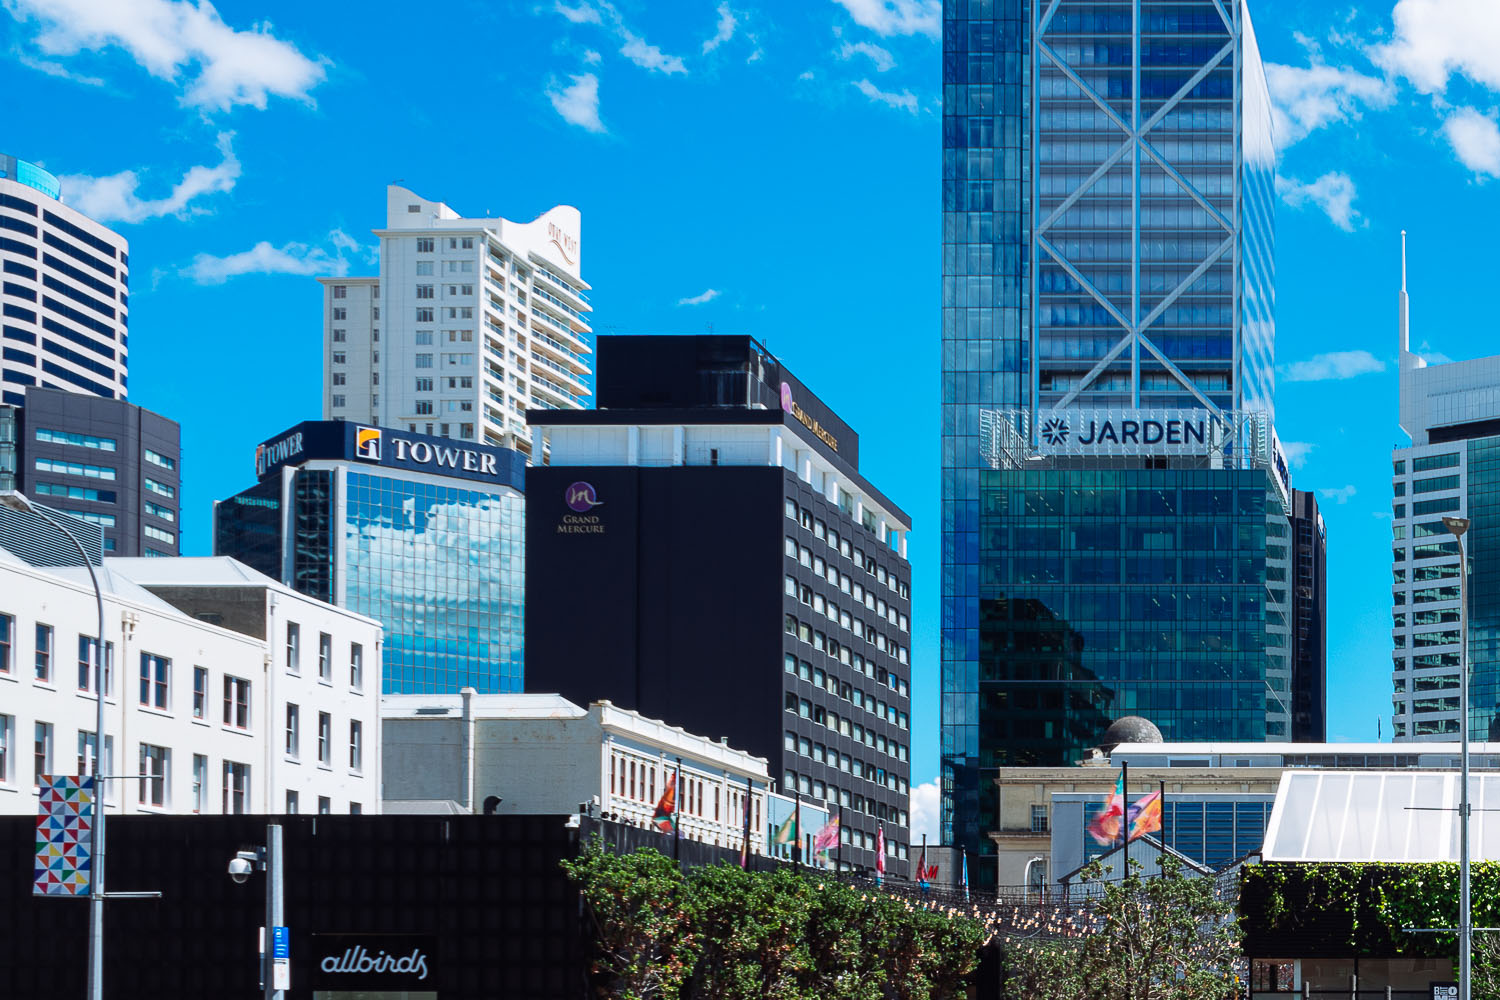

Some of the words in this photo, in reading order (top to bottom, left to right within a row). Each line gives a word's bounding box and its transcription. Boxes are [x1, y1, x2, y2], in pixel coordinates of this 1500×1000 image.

[1078, 420, 1205, 445] JARDEN
[265, 432, 304, 468] TOWER
[392, 437, 498, 475] TOWER
[557, 524, 606, 533] MERCURE
[563, 514, 600, 524] GRAND
[320, 944, 428, 980] allbirds
